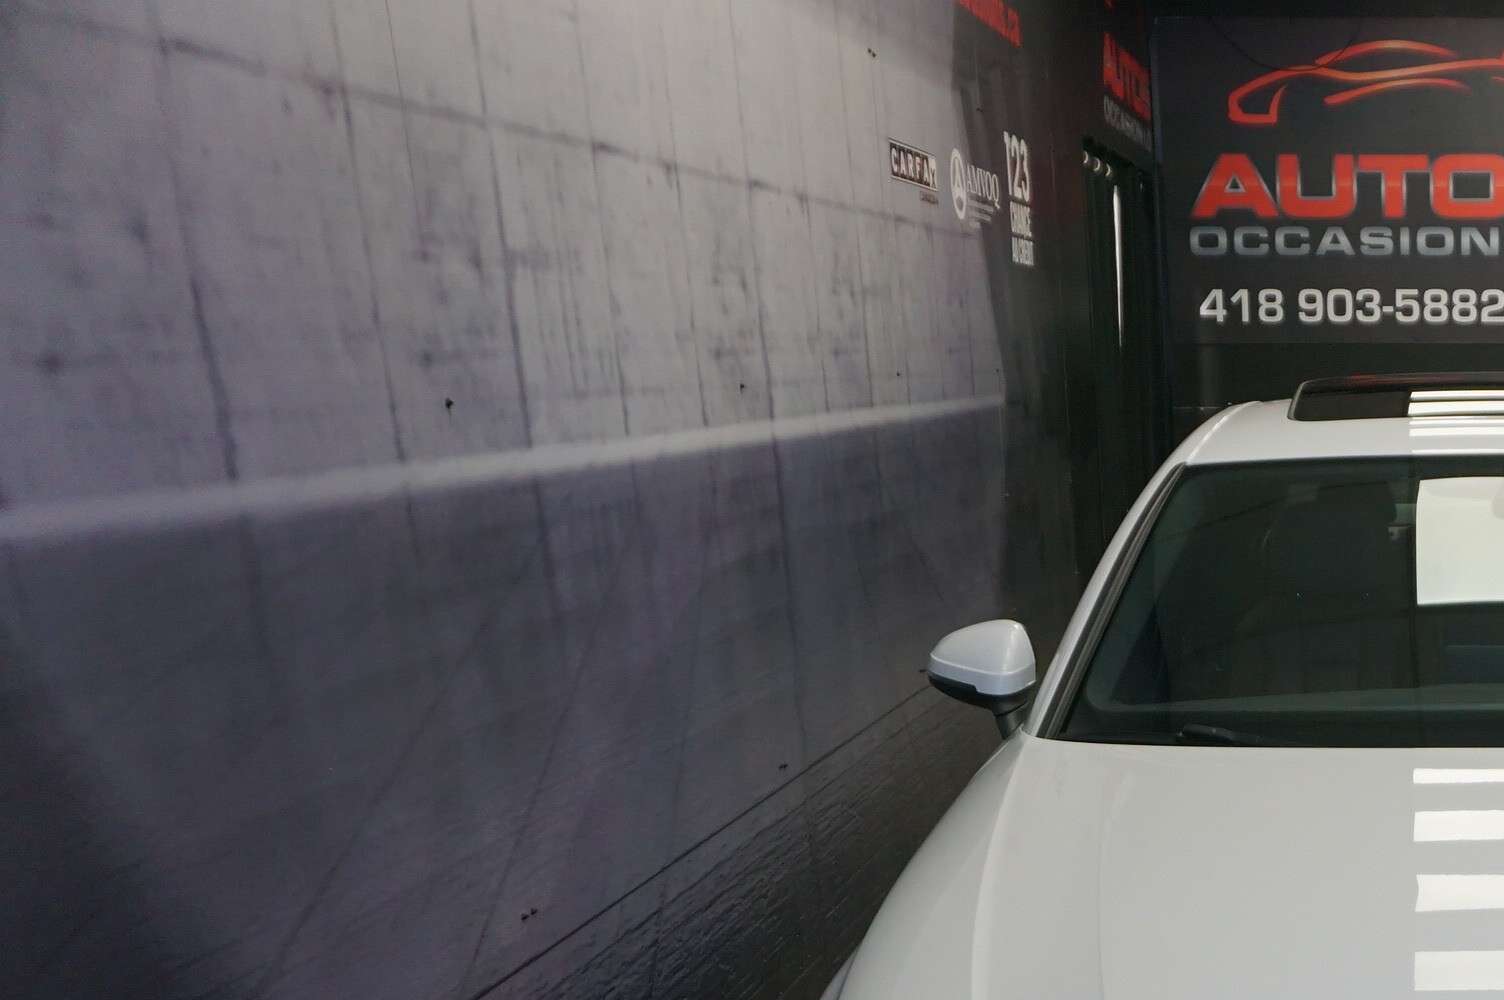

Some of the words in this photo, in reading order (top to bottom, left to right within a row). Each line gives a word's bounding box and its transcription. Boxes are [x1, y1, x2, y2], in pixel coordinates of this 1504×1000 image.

[891, 146, 938, 189] CARFAX
[1003, 131, 1030, 202] 123
[1190, 226, 1500, 257] OCCASION
[1199, 288, 1285, 324] 418
